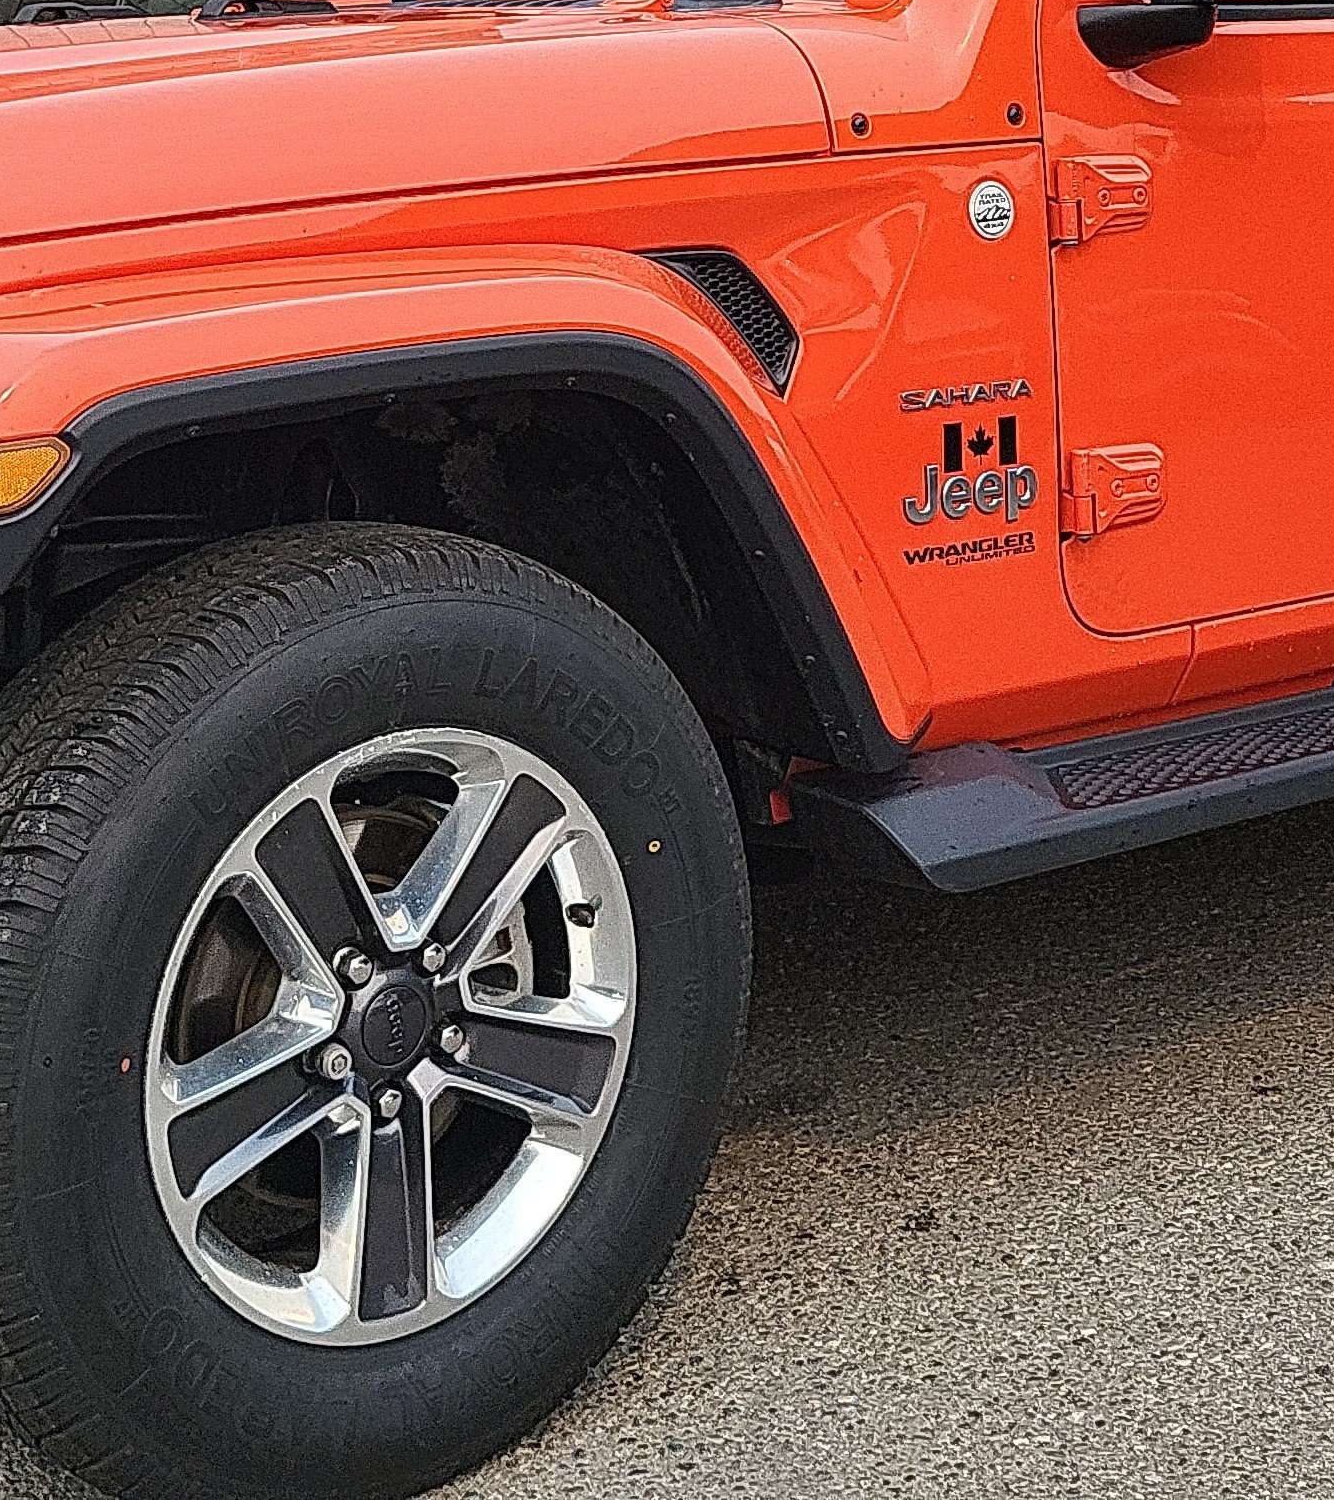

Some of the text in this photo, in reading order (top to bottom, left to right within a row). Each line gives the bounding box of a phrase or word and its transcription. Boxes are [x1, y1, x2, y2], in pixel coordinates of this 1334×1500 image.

[899, 378, 1032, 411] SAHARA
[902, 463, 1037, 524] Jeep
[903, 531, 1034, 566] WRANGLER
[945, 545, 1035, 566] UNLIMITED
[188, 645, 456, 818] UNIROYAL
[476, 647, 664, 798] LAREDO
